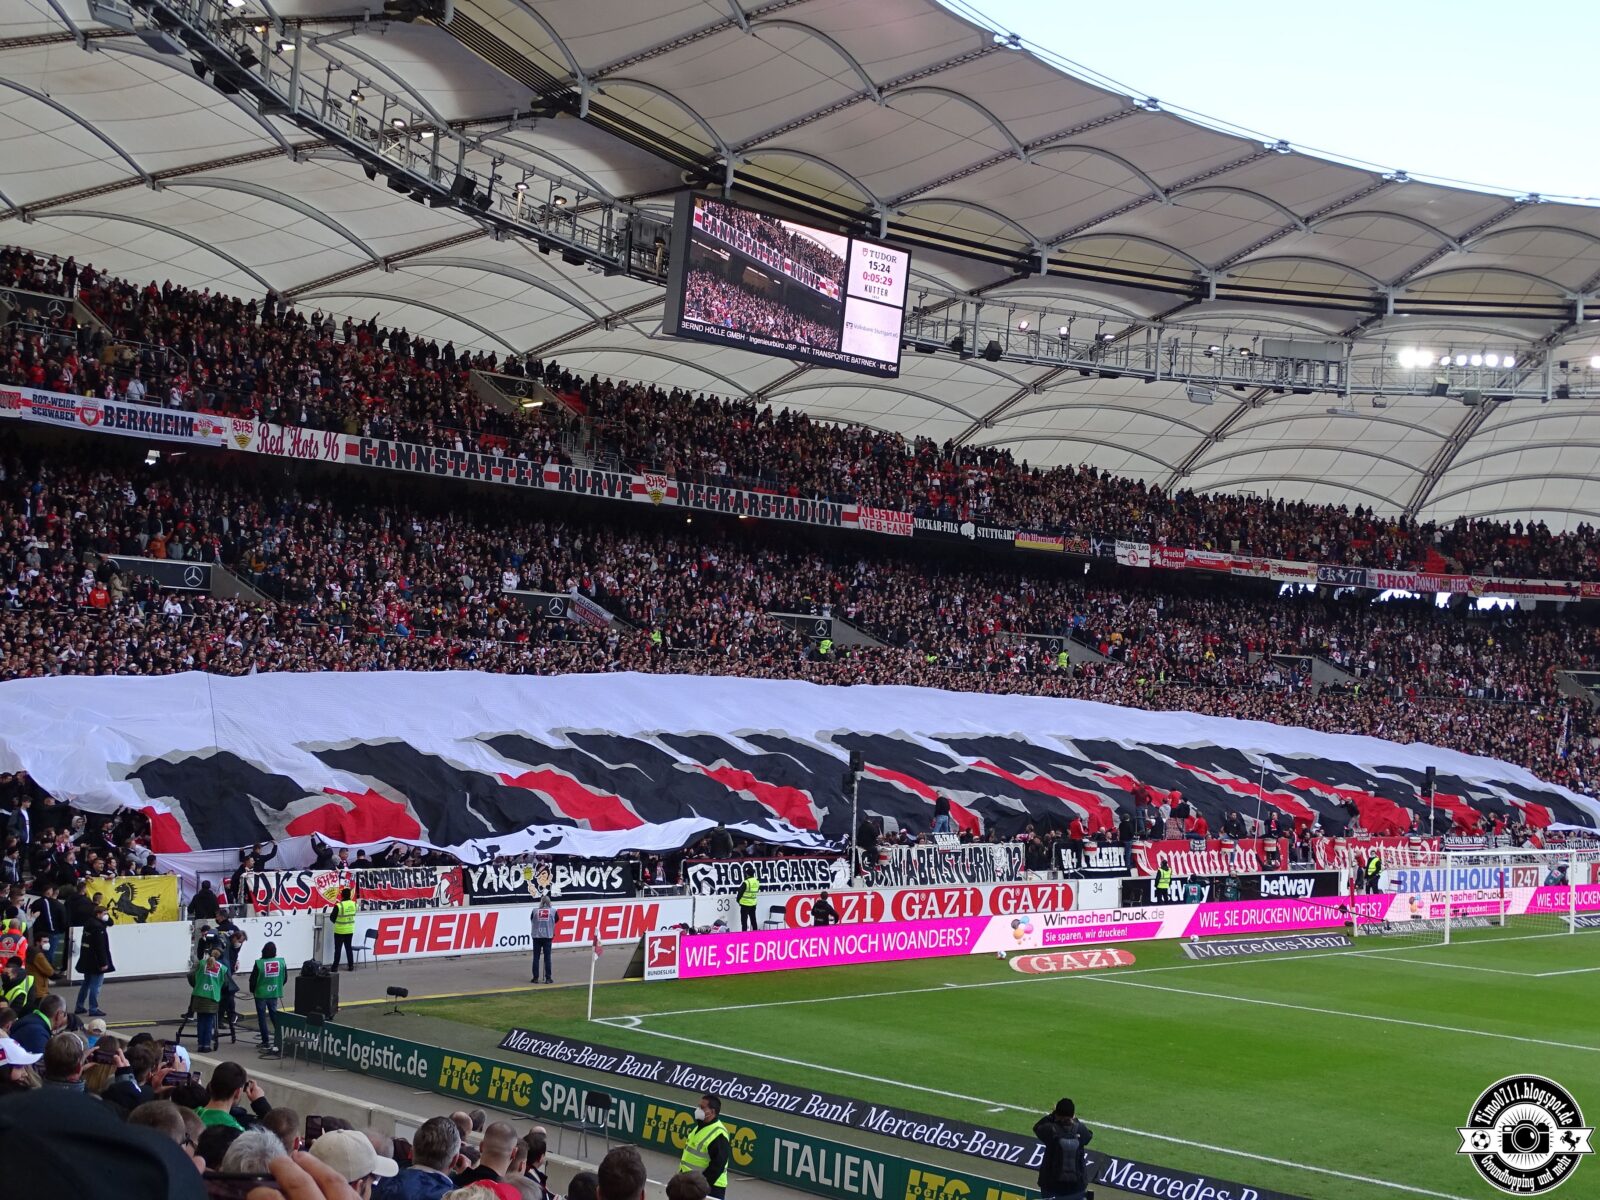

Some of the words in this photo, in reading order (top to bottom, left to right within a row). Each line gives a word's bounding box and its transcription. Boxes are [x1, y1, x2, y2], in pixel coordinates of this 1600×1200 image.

[869, 249, 898, 264] TUDOR
[868, 260, 891, 273] 15:24
[862, 271, 893, 287] 0:05:29
[864, 284, 889, 297] KUTTER
[704, 324, 726, 337] HÖLLE
[726, 330, 746, 341] GMBH
[749, 334, 785, 350] Ingenieurbüro
[785, 342, 797, 351] JSP
[800, 346, 811, 355] INT.
[812, 348, 851, 363] TRANSPORTE
[31, 406, 76, 422] SCHWABEN
[103, 404, 194, 437] BERKHEIM
[257, 421, 285, 456] Red
[287, 425, 319, 460] Hots
[323, 431, 340, 462] 96
[359, 437, 544, 488] CANNSTATTER
[558, 465, 633, 499] KURVE
[676, 481, 843, 527] NECKARSTADION
[860, 506, 913, 524] ALBSTADT
[862, 518, 913, 536] VFB-FANS
[913, 518, 959, 534] NECKAR-FILS
[976, 525, 1016, 541] STUTTGART
[1350, 569, 1362, 583] 77
[1416, 575, 1441, 592] DONAU
[1450, 578, 1469, 593] RIES
[1260, 874, 1316, 899] betway
[1517, 869, 1538, 887] 247
[1092, 882, 1103, 894] 34
[716, 898, 731, 913] 33
[1554, 892, 1566, 906] SIE
[552, 903, 660, 944] EHEIM
[1043, 908, 1165, 927] WirmachenDruck.de
[1200, 911, 1221, 929] WIE,
[1224, 910, 1239, 926] SIE
[1241, 907, 1290, 925] DRUCKEN
[1292, 904, 1319, 922] NOCH
[263, 921, 283, 938] 32
[1045, 931, 1057, 943] Sie
[1057, 929, 1083, 942] sparen,
[1085, 928, 1098, 939] wir
[1099, 926, 1128, 938] drucken!
[685, 945, 721, 968] WIE,
[725, 943, 750, 965] SIE
[753, 938, 829, 963] DRUCKEN
[833, 933, 881, 956] NOCH
[882, 927, 972, 951] WOANDERS?
[1194, 935, 1352, 958] Mercedes-Benz
[647, 969, 676, 977] BUNDESLIGA
[438, 1055, 483, 1096] ITC
[487, 1066, 534, 1107] ITC
[502, 1030, 619, 1072] Mercedes-Benz
[614, 1054, 664, 1081] Bank
[665, 1064, 803, 1112] Mercedes-Benz
[800, 1091, 856, 1125] Bank
[859, 1106, 1026, 1165] Mercedes-Benz
[642, 1103, 695, 1150] ITC
[772, 1136, 886, 1200] ITALIEN
